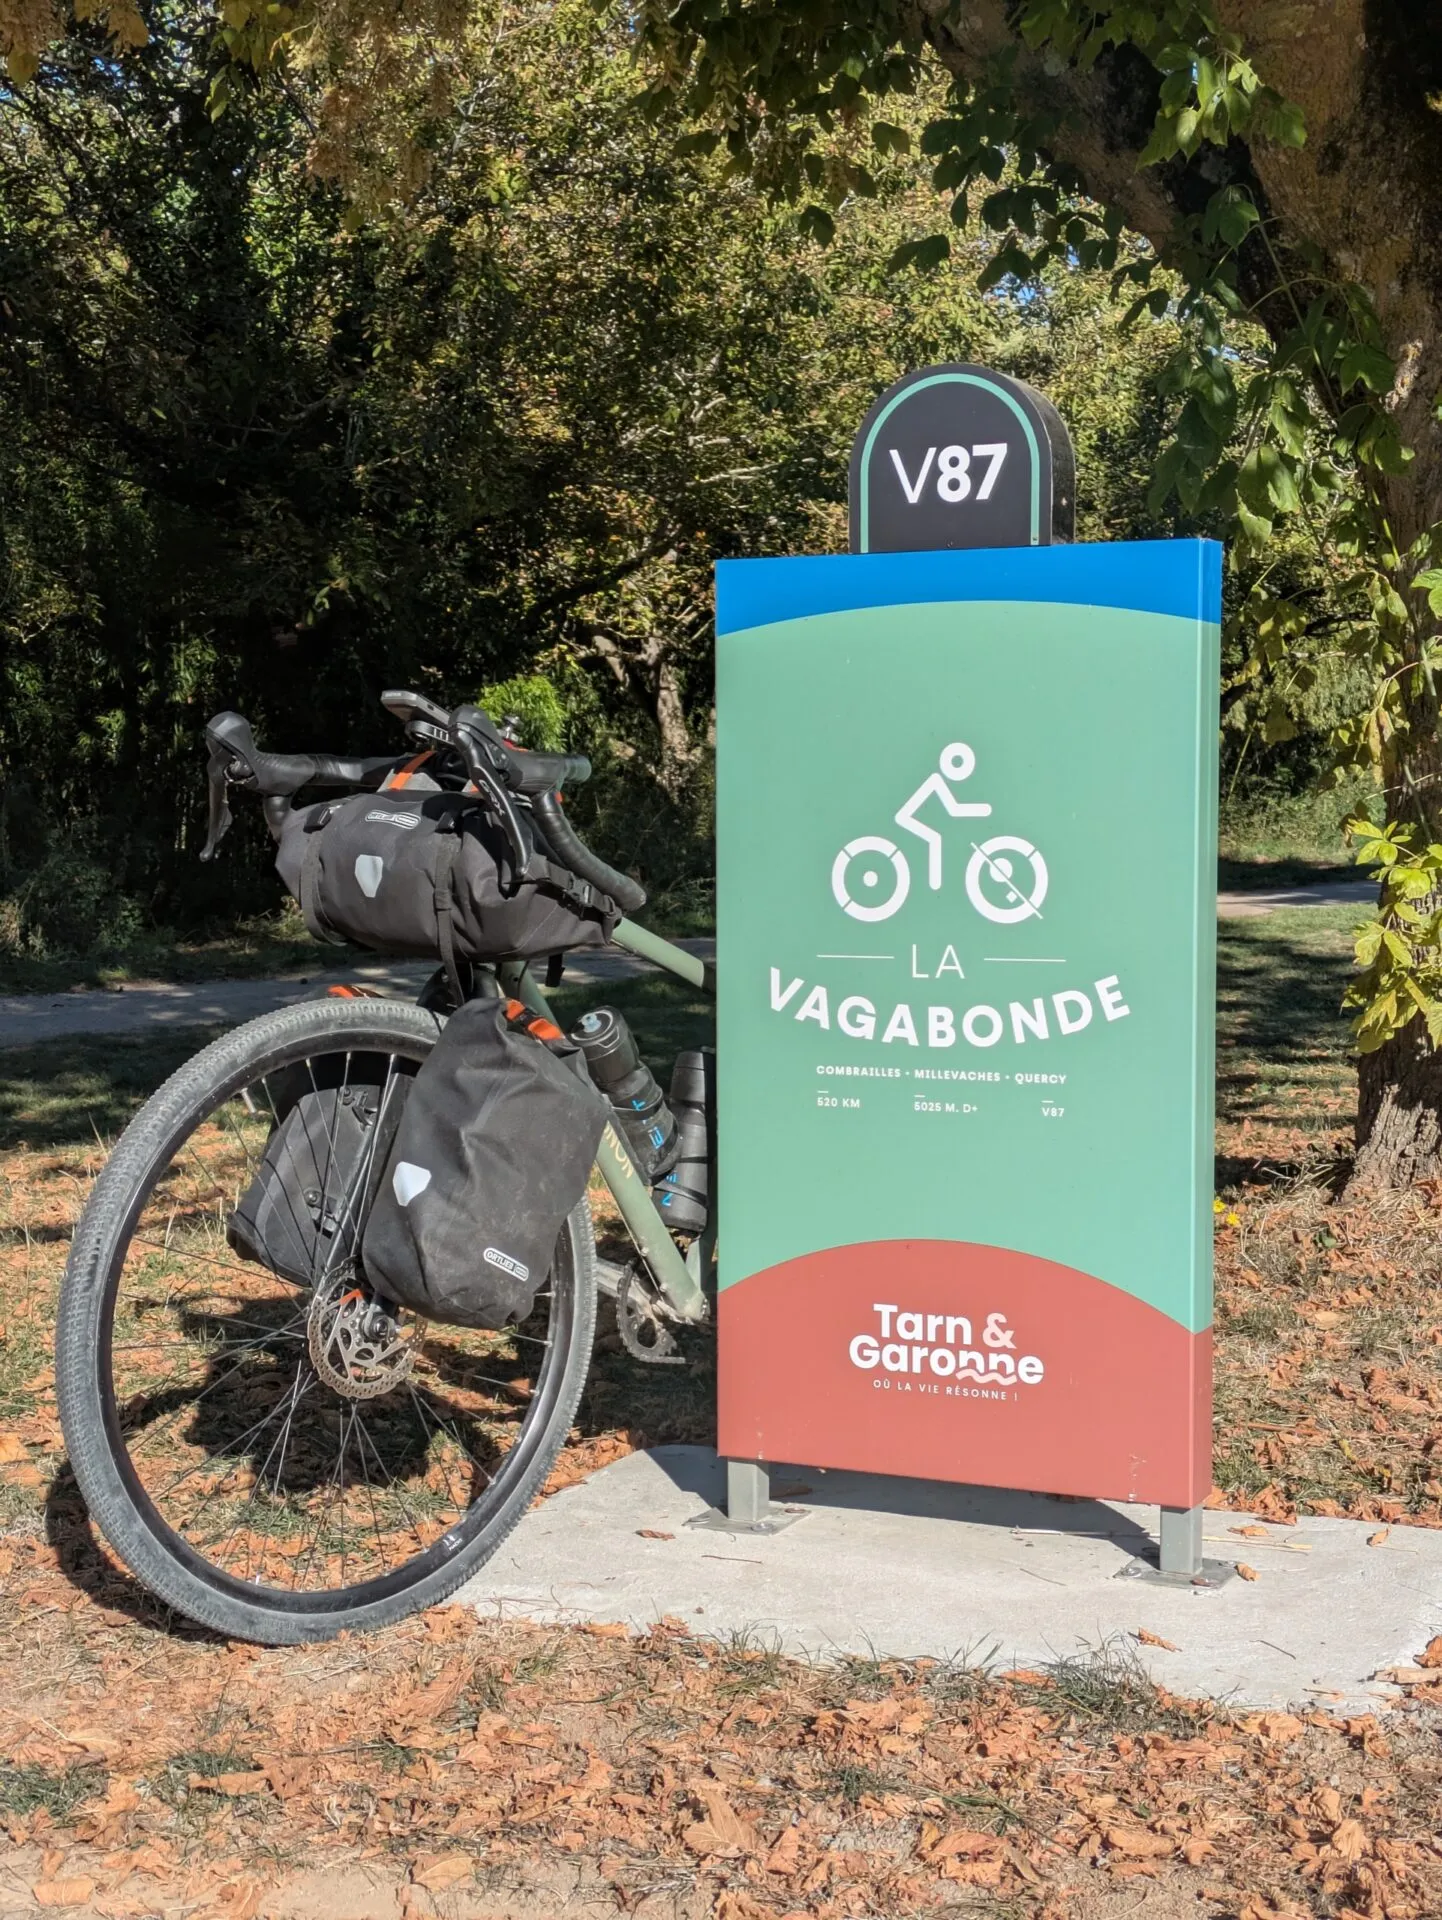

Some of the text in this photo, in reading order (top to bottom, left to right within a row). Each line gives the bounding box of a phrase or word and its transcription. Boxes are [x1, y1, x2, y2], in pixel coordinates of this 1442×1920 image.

[889, 442, 1008, 504] V87
[911, 943, 966, 980] LA
[769, 965, 1131, 1048] VAGABONDE
[816, 1065, 1067, 1085] COMBRAILLES MILLEVACHES QUERCY
[817, 1097, 861, 1109] 520 KM
[914, 1101, 942, 1112] 5025
[1041, 1107, 1066, 1117] V87
[873, 1303, 1018, 1350] Tarn &
[849, 1334, 1044, 1385] Garonne
[897, 1381, 912, 1391] LA
[919, 1383, 940, 1394] VIE
[946, 1385, 1008, 1400] RÉSONNE
